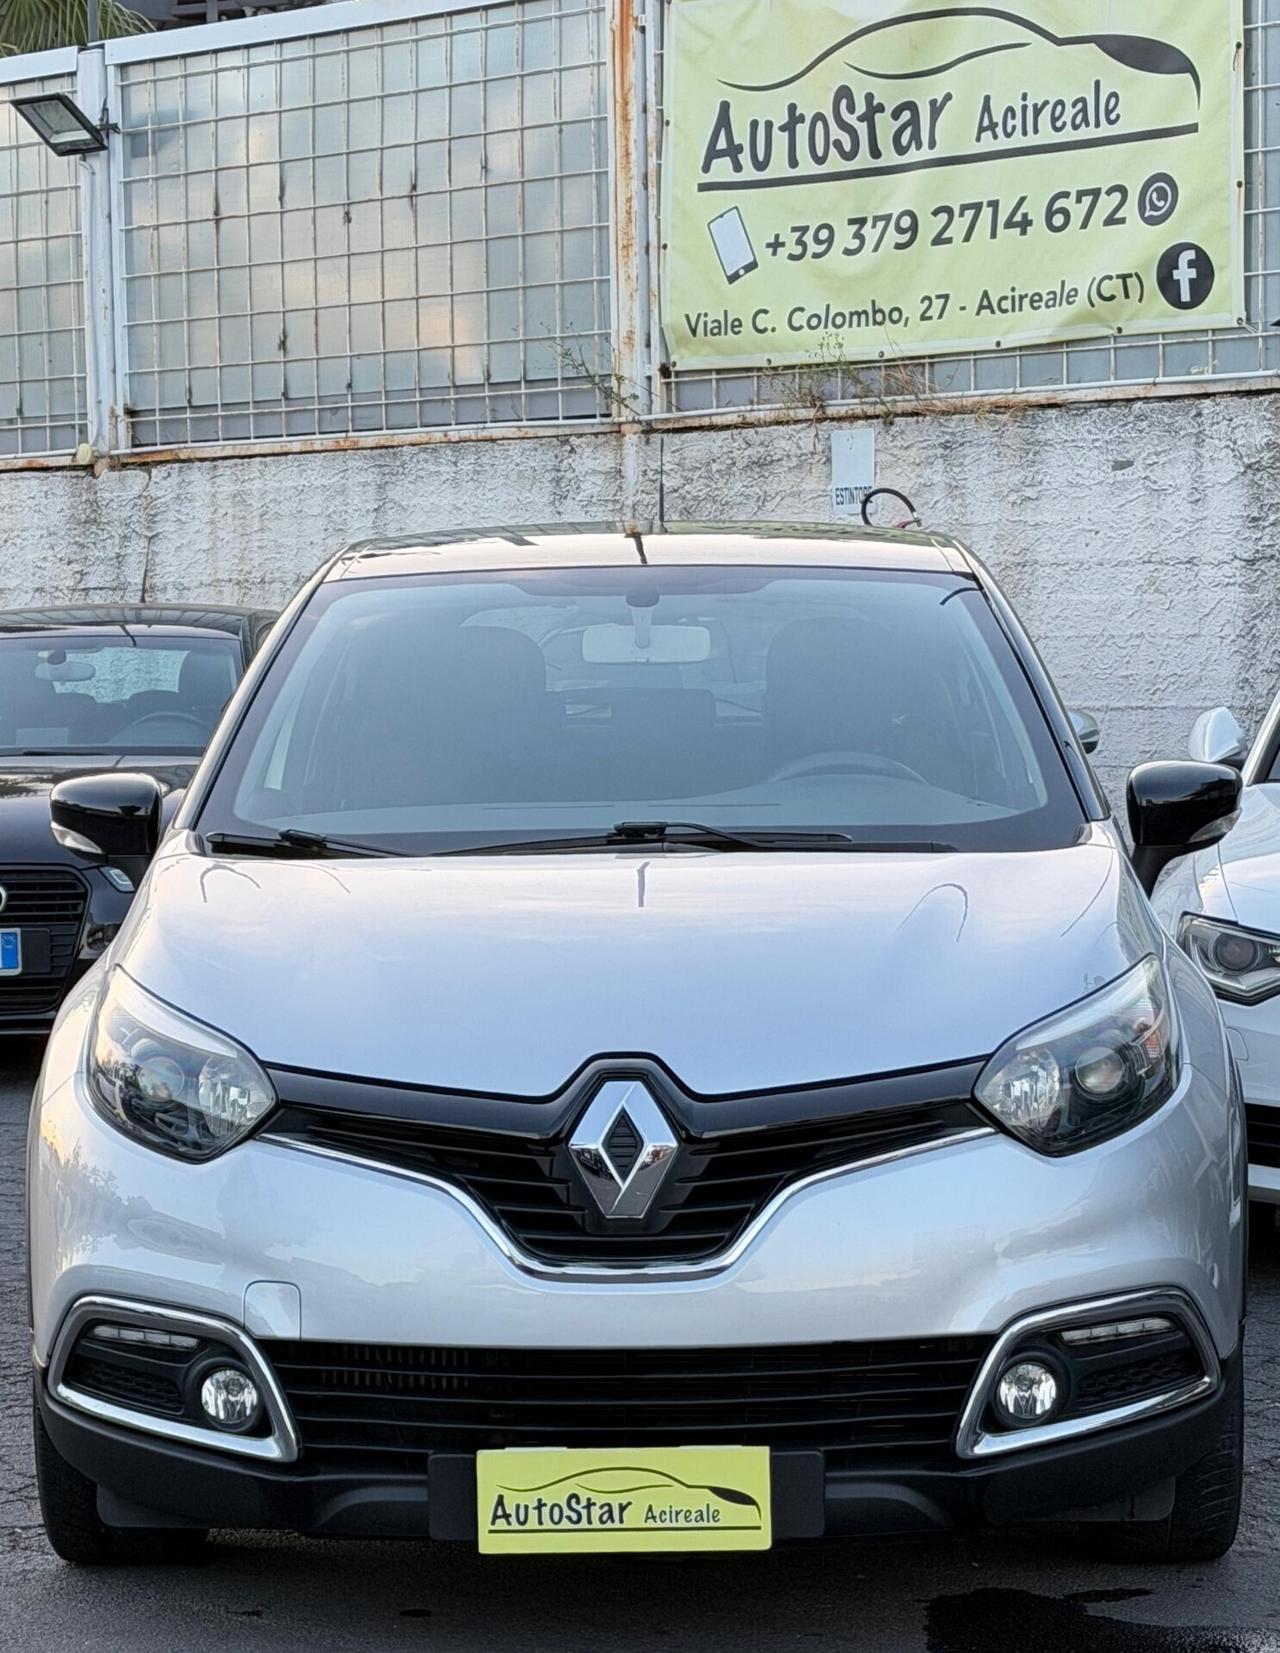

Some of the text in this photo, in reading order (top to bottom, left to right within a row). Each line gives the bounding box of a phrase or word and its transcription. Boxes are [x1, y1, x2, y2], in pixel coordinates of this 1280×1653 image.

[701, 79, 1121, 175] AutoStar Acireale
[765, 184, 1129, 261] +39 379 2714 672
[685, 309, 743, 338] Viale
[751, 308, 777, 334] C.
[787, 299, 910, 332] Colombo,
[919, 293, 951, 321] 27
[975, 280, 1079, 316] Acireale
[1087, 271, 1145, 309] (CT)
[490, 1493, 721, 1526] AutoStar Acireale
